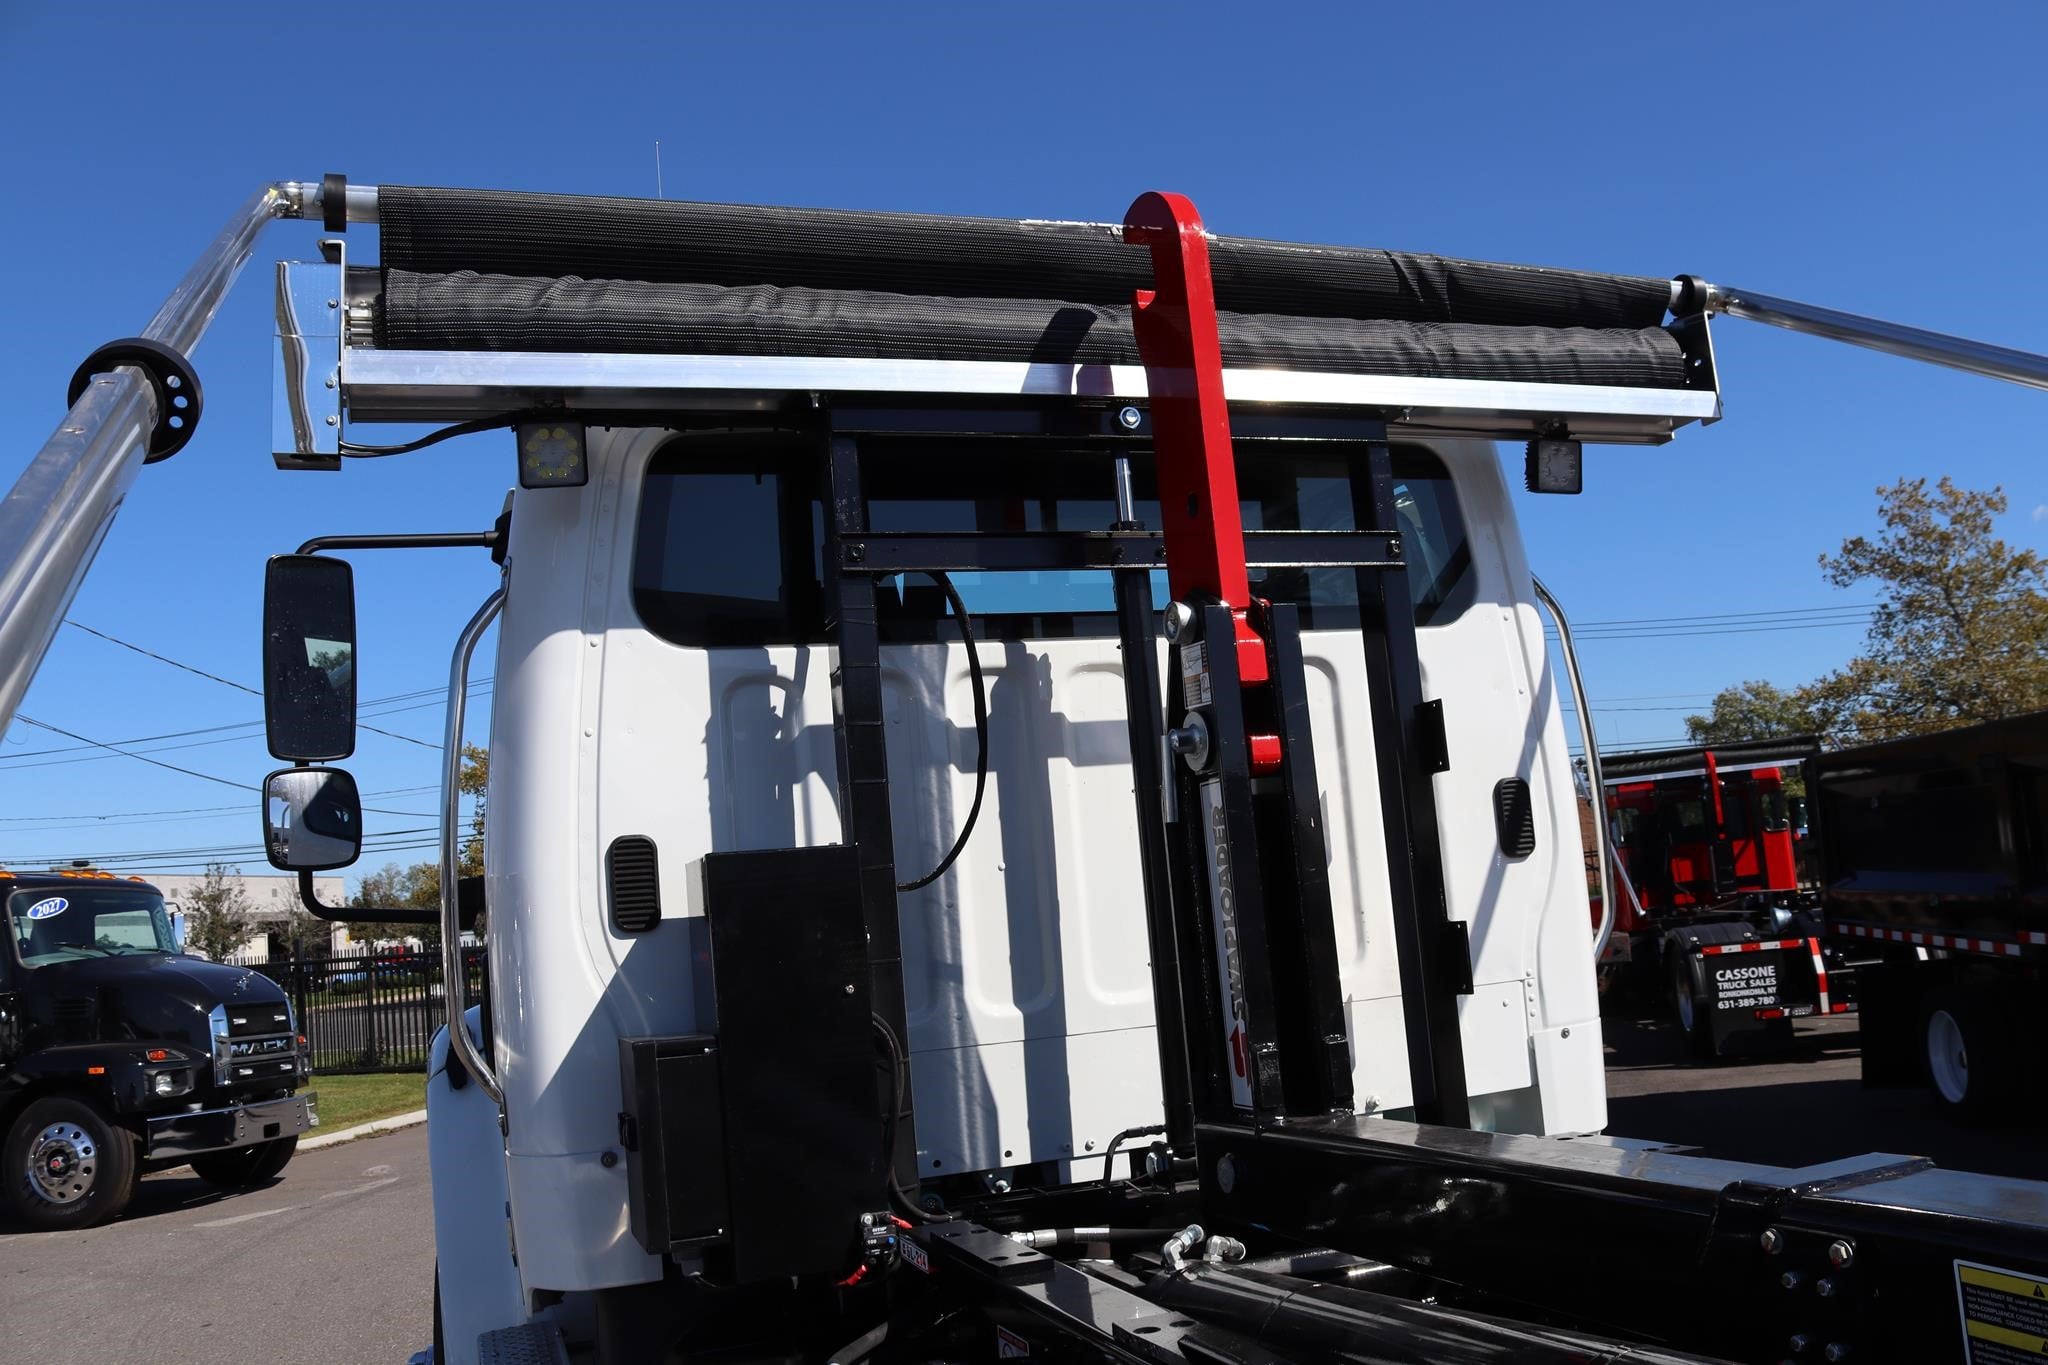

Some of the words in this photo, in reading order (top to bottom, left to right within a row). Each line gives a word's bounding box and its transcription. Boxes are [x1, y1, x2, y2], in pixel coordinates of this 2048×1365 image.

[35, 899, 60, 917] 2027
[1212, 804, 1247, 1021] SWAPLOADER
[1715, 965, 1776, 981] CASSONE
[1717, 980, 1747, 990] TRUCK
[1750, 977, 1777, 987] SALES
[1767, 986, 1777, 994] NY
[1718, 995, 1780, 1009] 631-389-780
[230, 1039, 287, 1056] MACK
